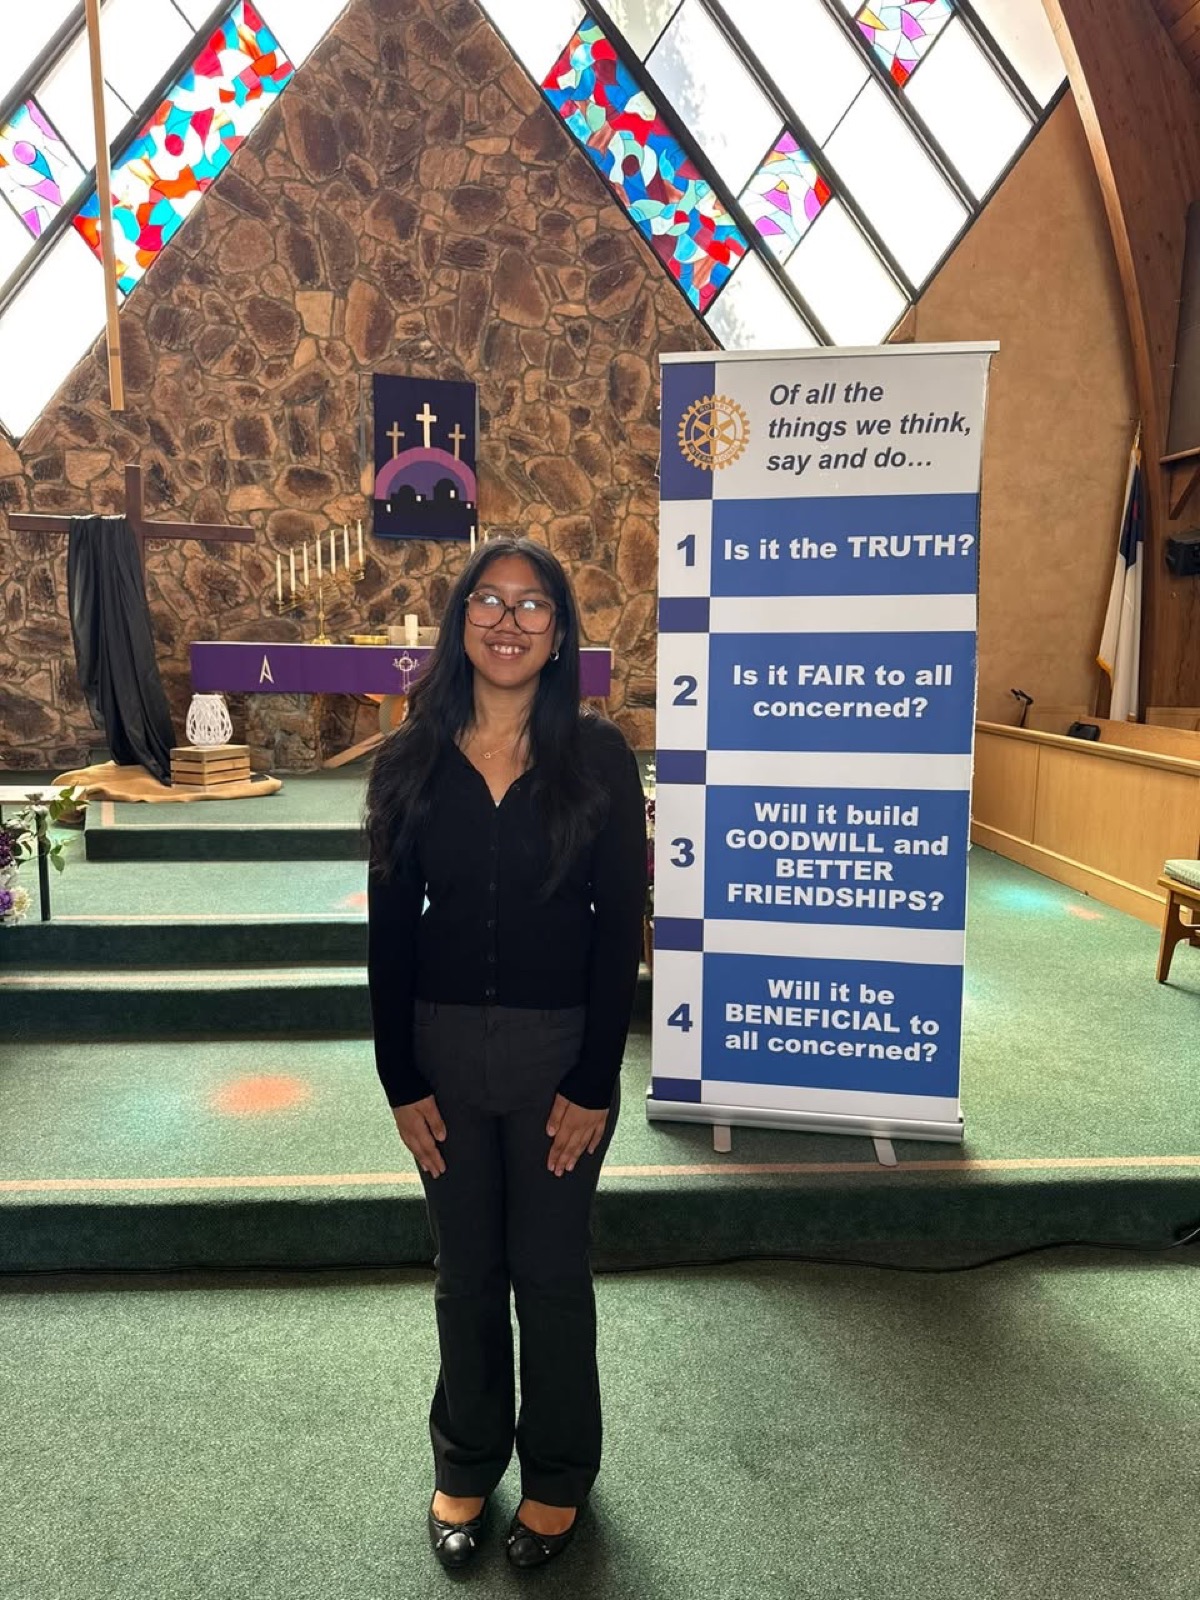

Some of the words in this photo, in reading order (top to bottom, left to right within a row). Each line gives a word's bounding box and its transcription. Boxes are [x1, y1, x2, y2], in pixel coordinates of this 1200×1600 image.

[770, 384, 801, 405] Of
[806, 383, 836, 404] all
[844, 382, 883, 403] the
[769, 417, 847, 441] things
[857, 420, 891, 435] we
[900, 411, 970, 436] think,
[767, 455, 811, 475] say
[819, 448, 867, 469] and
[677, 534, 696, 566] 1
[725, 540, 749, 560] Is
[760, 539, 779, 559] it
[790, 538, 837, 559] the
[848, 534, 974, 557] TRUTH?
[734, 665, 757, 685] Is
[769, 665, 787, 685] it
[799, 665, 865, 685] FAIR
[875, 666, 905, 685] to
[916, 665, 951, 685] all
[673, 675, 697, 706] 2
[754, 698, 927, 717] concerned?
[755, 803, 806, 823] Will
[818, 805, 836, 824] it
[847, 805, 918, 826] build
[671, 838, 694, 867] 3
[726, 829, 884, 852] GOODWILL
[894, 836, 948, 855] and
[777, 859, 893, 881] BETTER
[729, 884, 944, 911] FRIENDSHIPS?
[768, 979, 819, 1000] Will
[831, 983, 849, 1002] it
[860, 984, 894, 1004] be
[668, 1004, 693, 1032] 4
[725, 1003, 900, 1033] BENEFICIAL
[910, 1016, 939, 1035] to
[726, 1031, 757, 1050] all
[768, 1035, 938, 1061] concerned?
